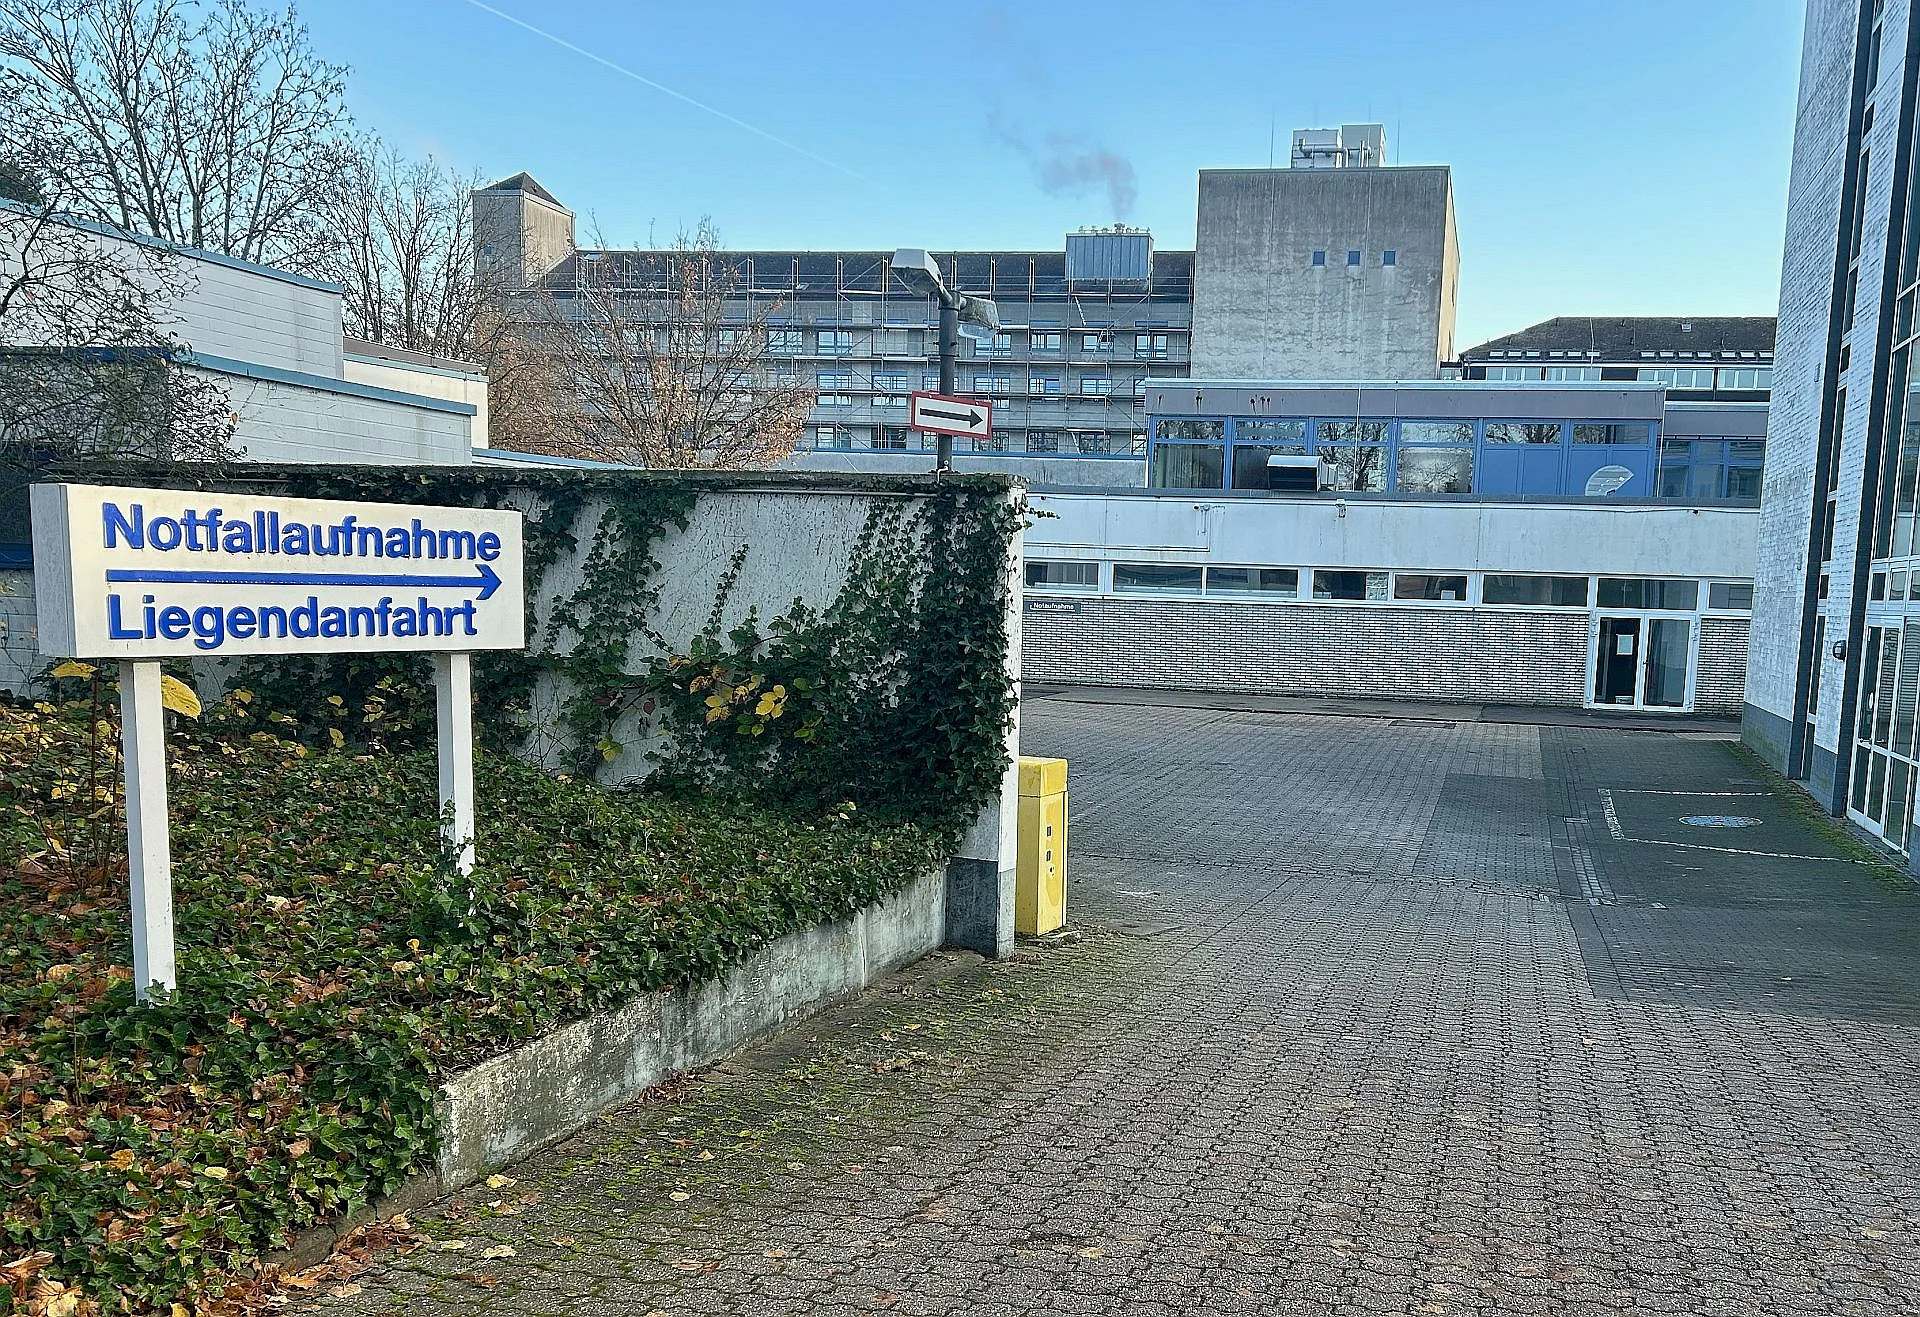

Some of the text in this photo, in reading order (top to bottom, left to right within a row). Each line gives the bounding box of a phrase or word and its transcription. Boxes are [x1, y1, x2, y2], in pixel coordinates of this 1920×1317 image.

[102, 502, 502, 562] Notfallaufnahme
[107, 594, 478, 650] Liegendanfahrt
[1032, 601, 1075, 610] Notaufnahme
